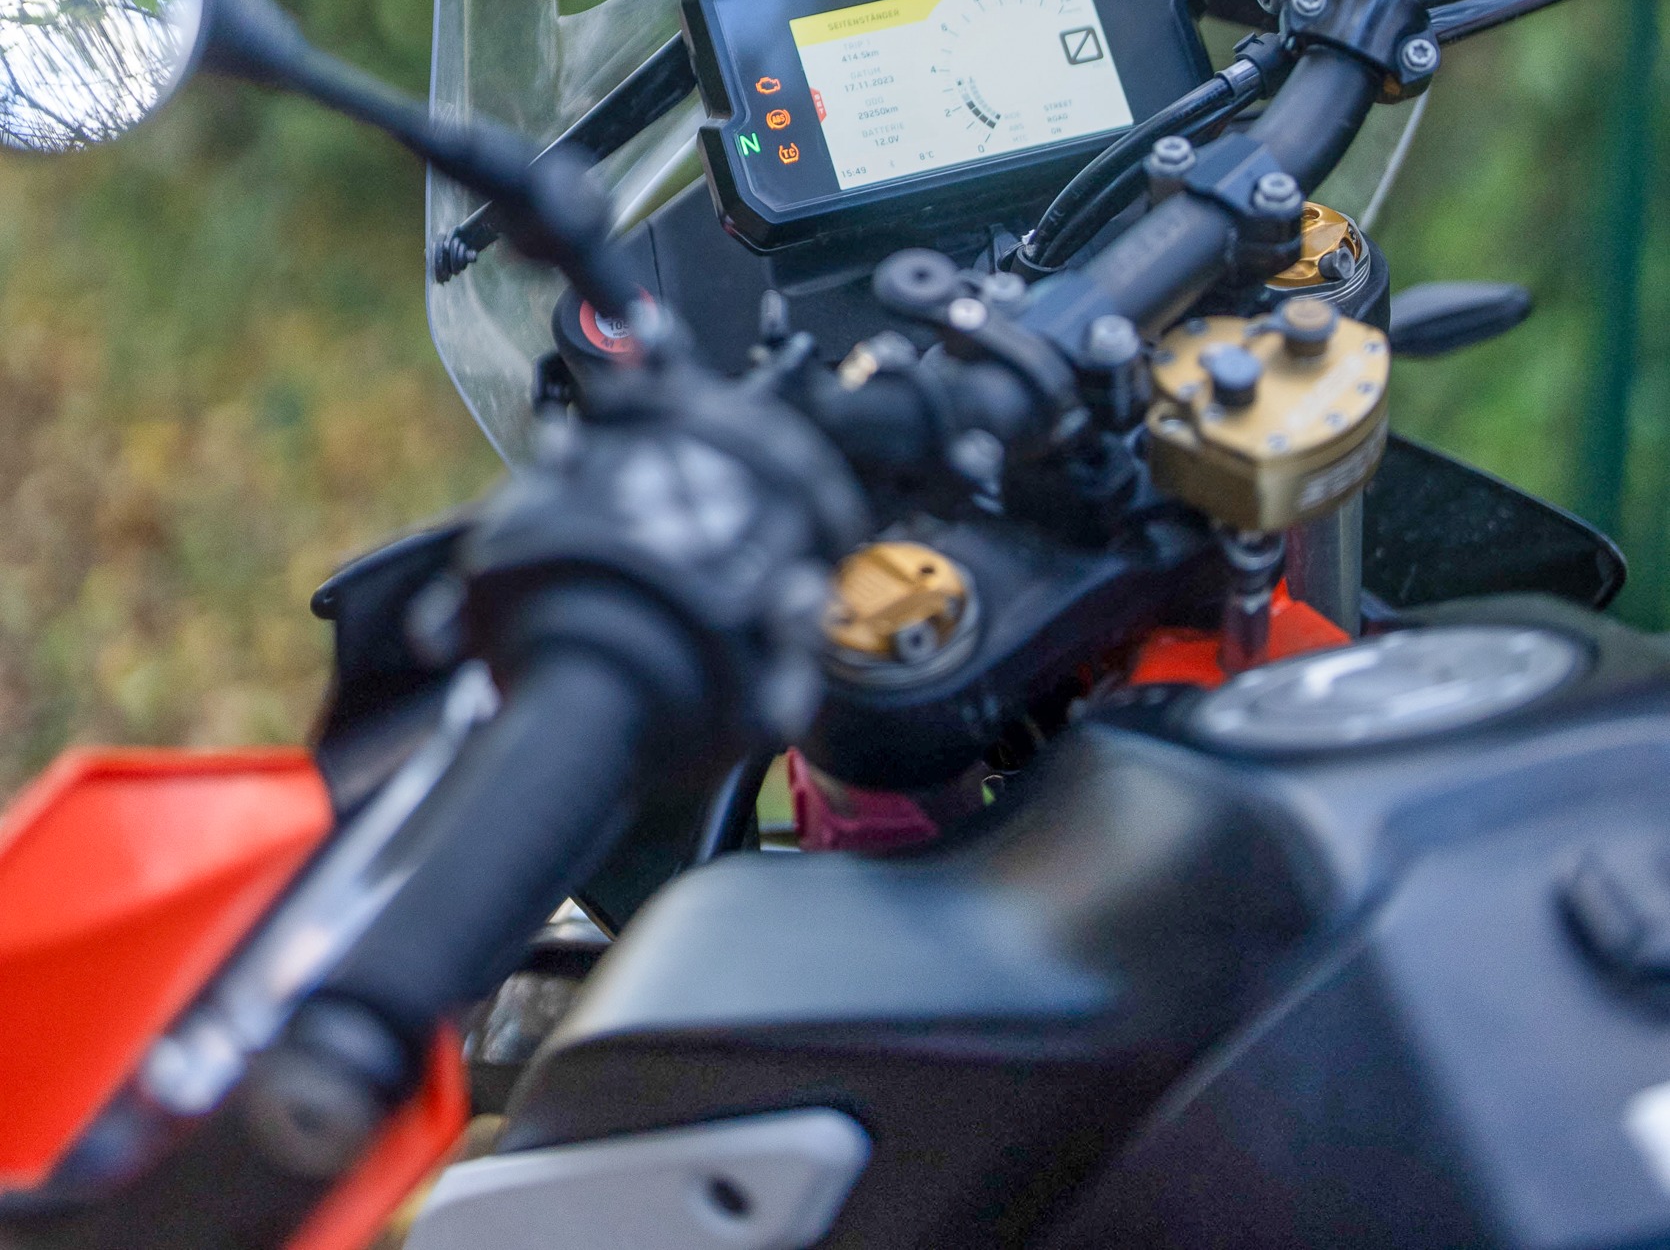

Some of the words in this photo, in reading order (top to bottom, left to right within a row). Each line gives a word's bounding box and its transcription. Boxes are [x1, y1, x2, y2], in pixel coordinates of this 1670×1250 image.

[843, 75, 895, 92] 17.11.2023
[858, 106, 899, 121] 29250km
[740, 133, 761, 156] N
[875, 135, 900, 147] 12.0V
[841, 166, 867, 179] 15:49
